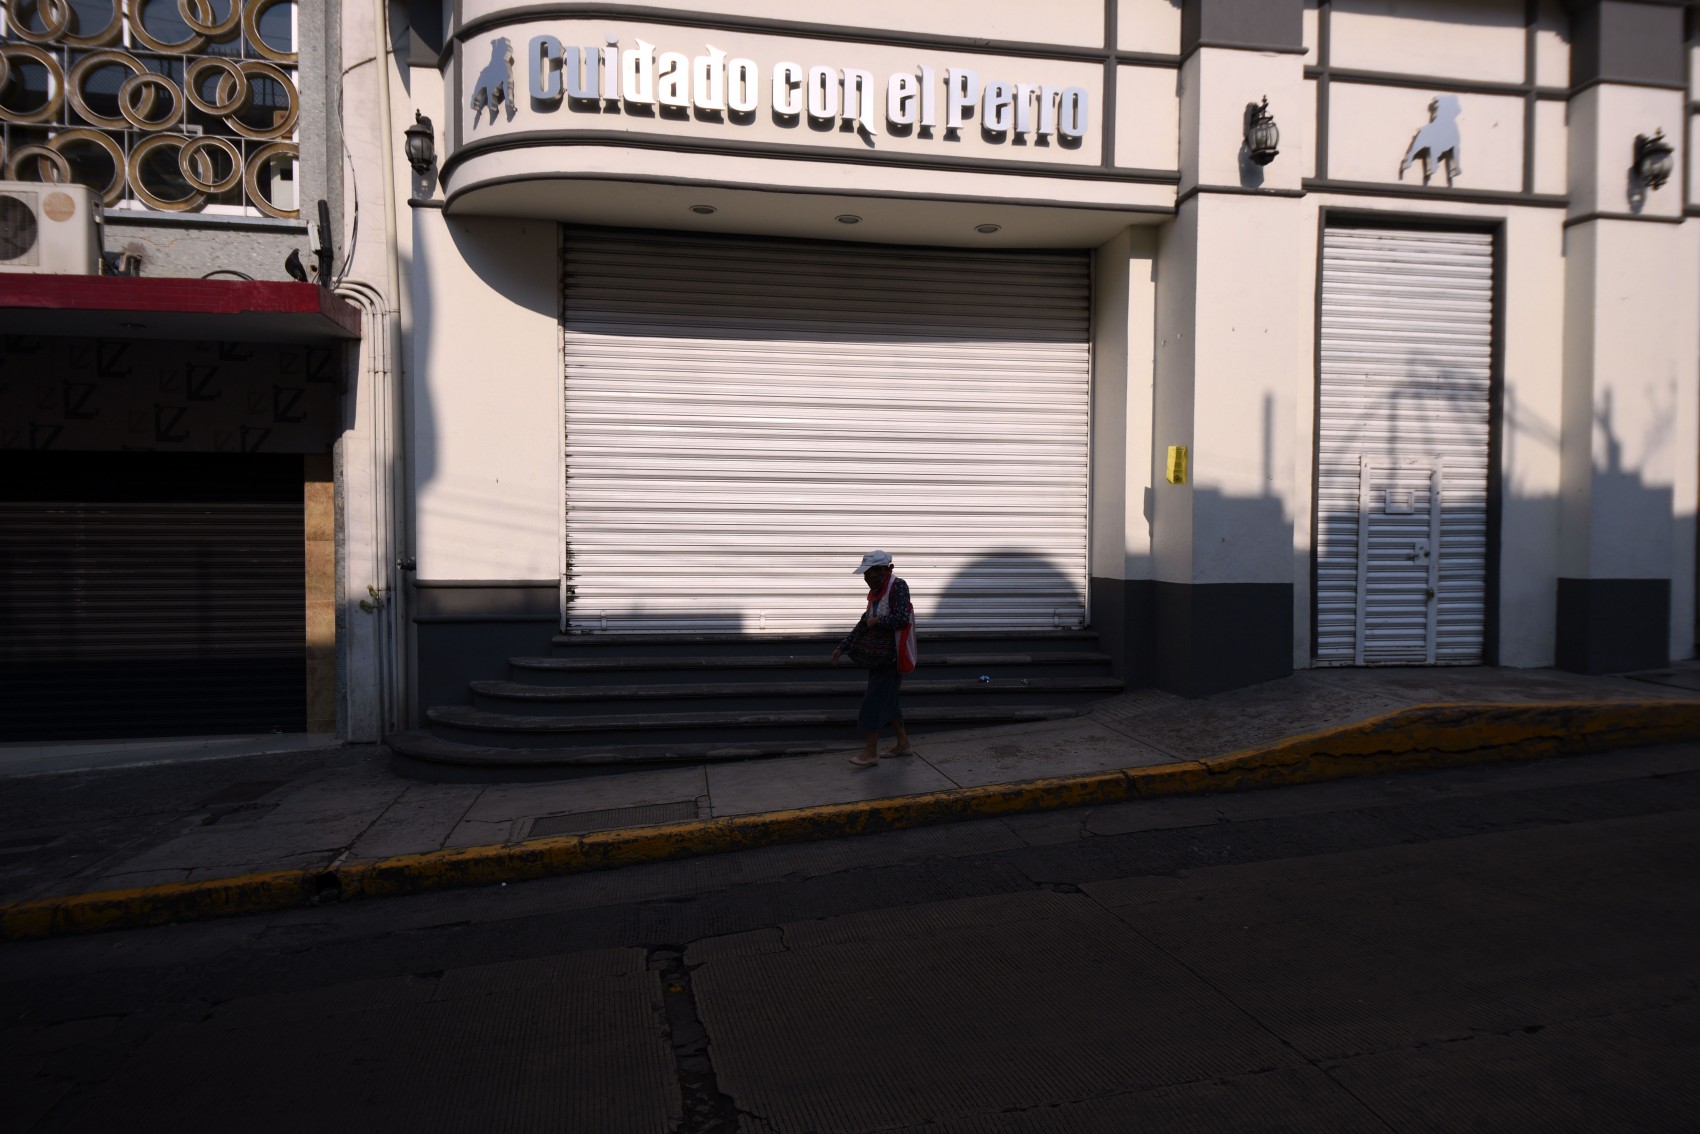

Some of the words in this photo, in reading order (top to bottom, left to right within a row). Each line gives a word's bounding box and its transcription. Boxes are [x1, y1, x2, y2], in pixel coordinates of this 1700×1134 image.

[529, 34, 759, 112] Cuidado
[772, 61, 877, 136] con
[887, 64, 936, 126] el
[945, 67, 1089, 137] Perro
